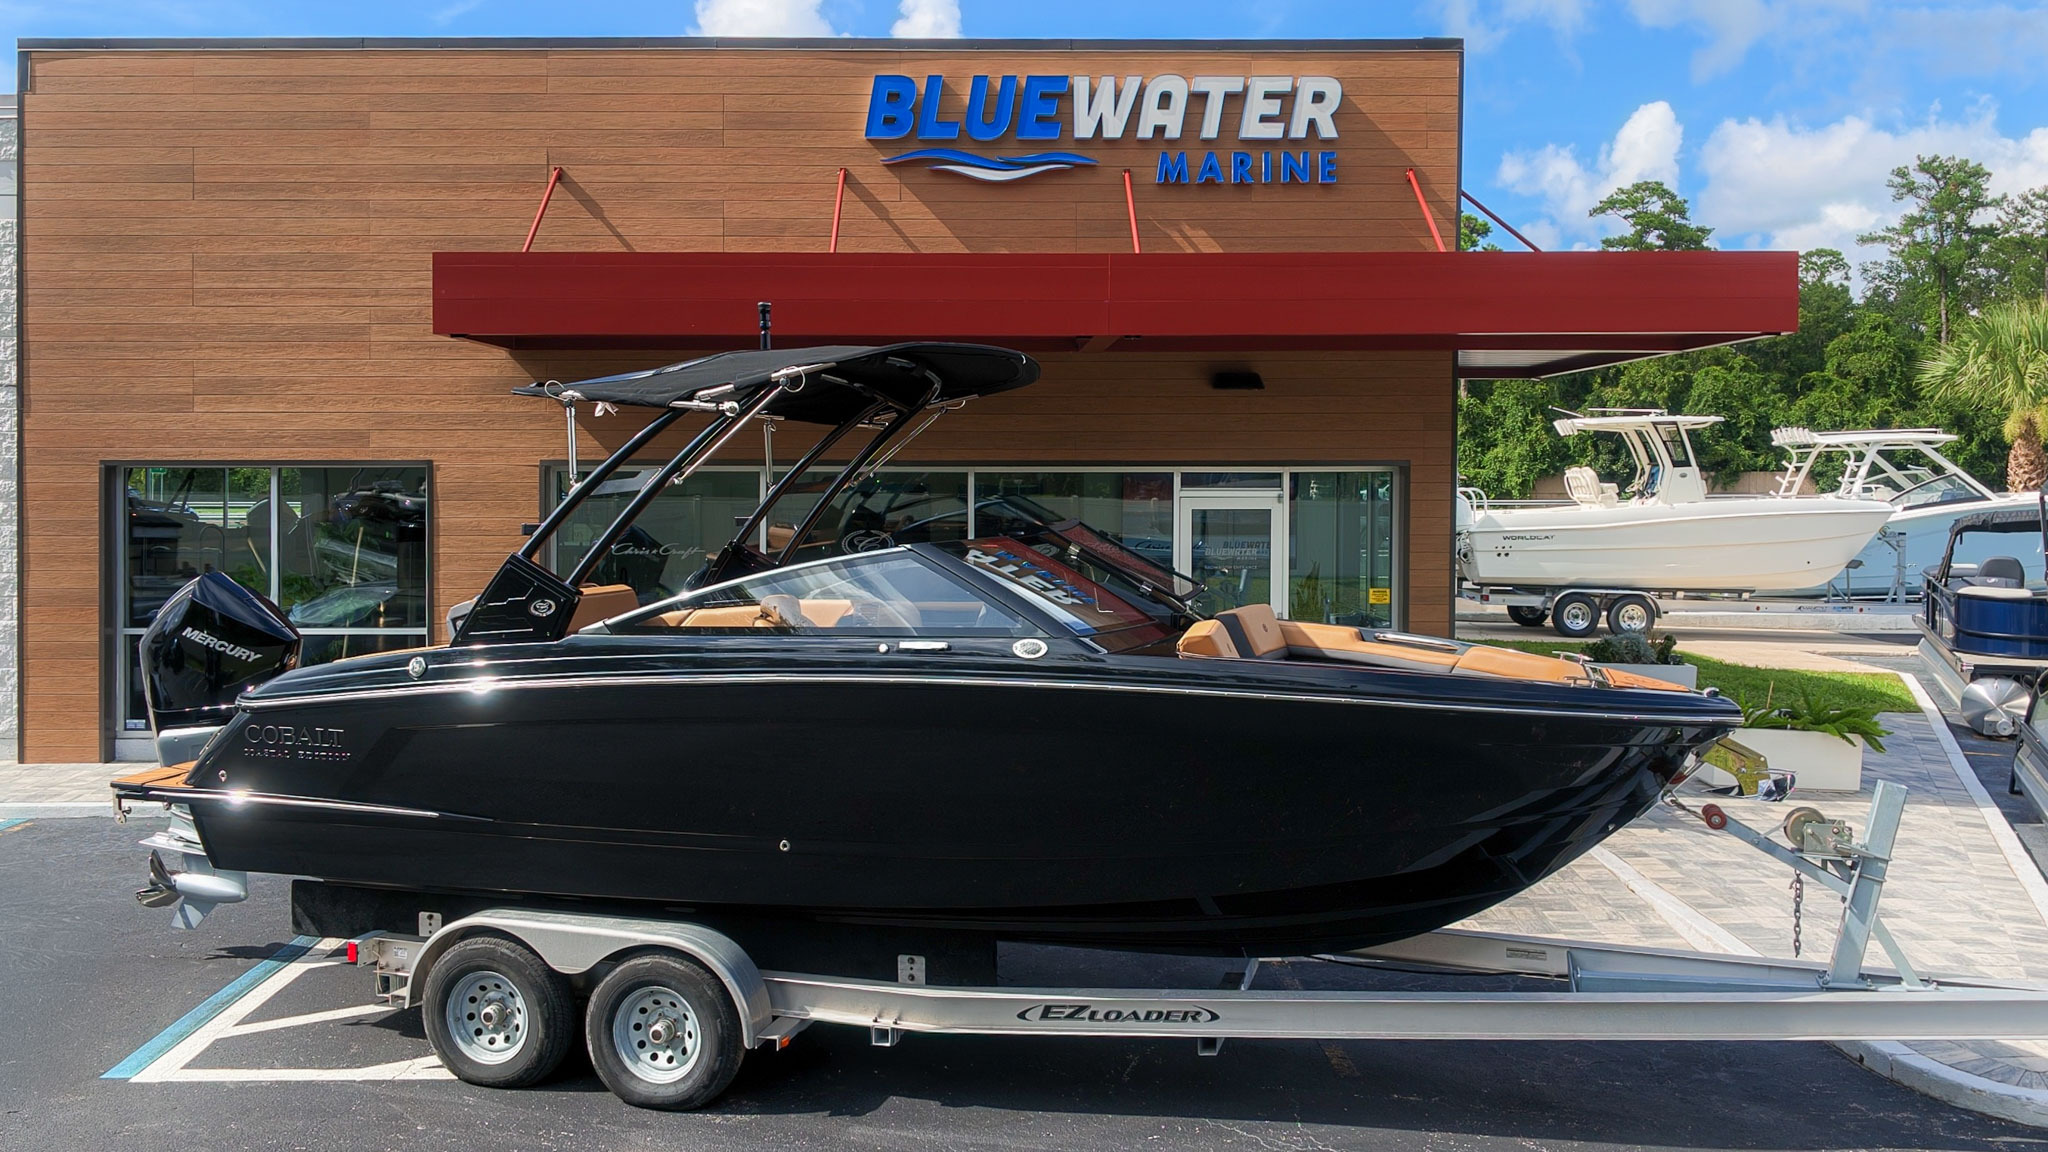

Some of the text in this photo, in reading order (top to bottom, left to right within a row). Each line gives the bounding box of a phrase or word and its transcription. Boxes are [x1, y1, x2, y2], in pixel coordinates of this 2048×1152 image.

[864, 74, 1343, 141] BLUEWATER
[1156, 151, 1337, 183] MARINE
[1222, 541, 1271, 549] BLUEWATE
[182, 626, 263, 662] MERCURY
[244, 724, 345, 748] COBALT
